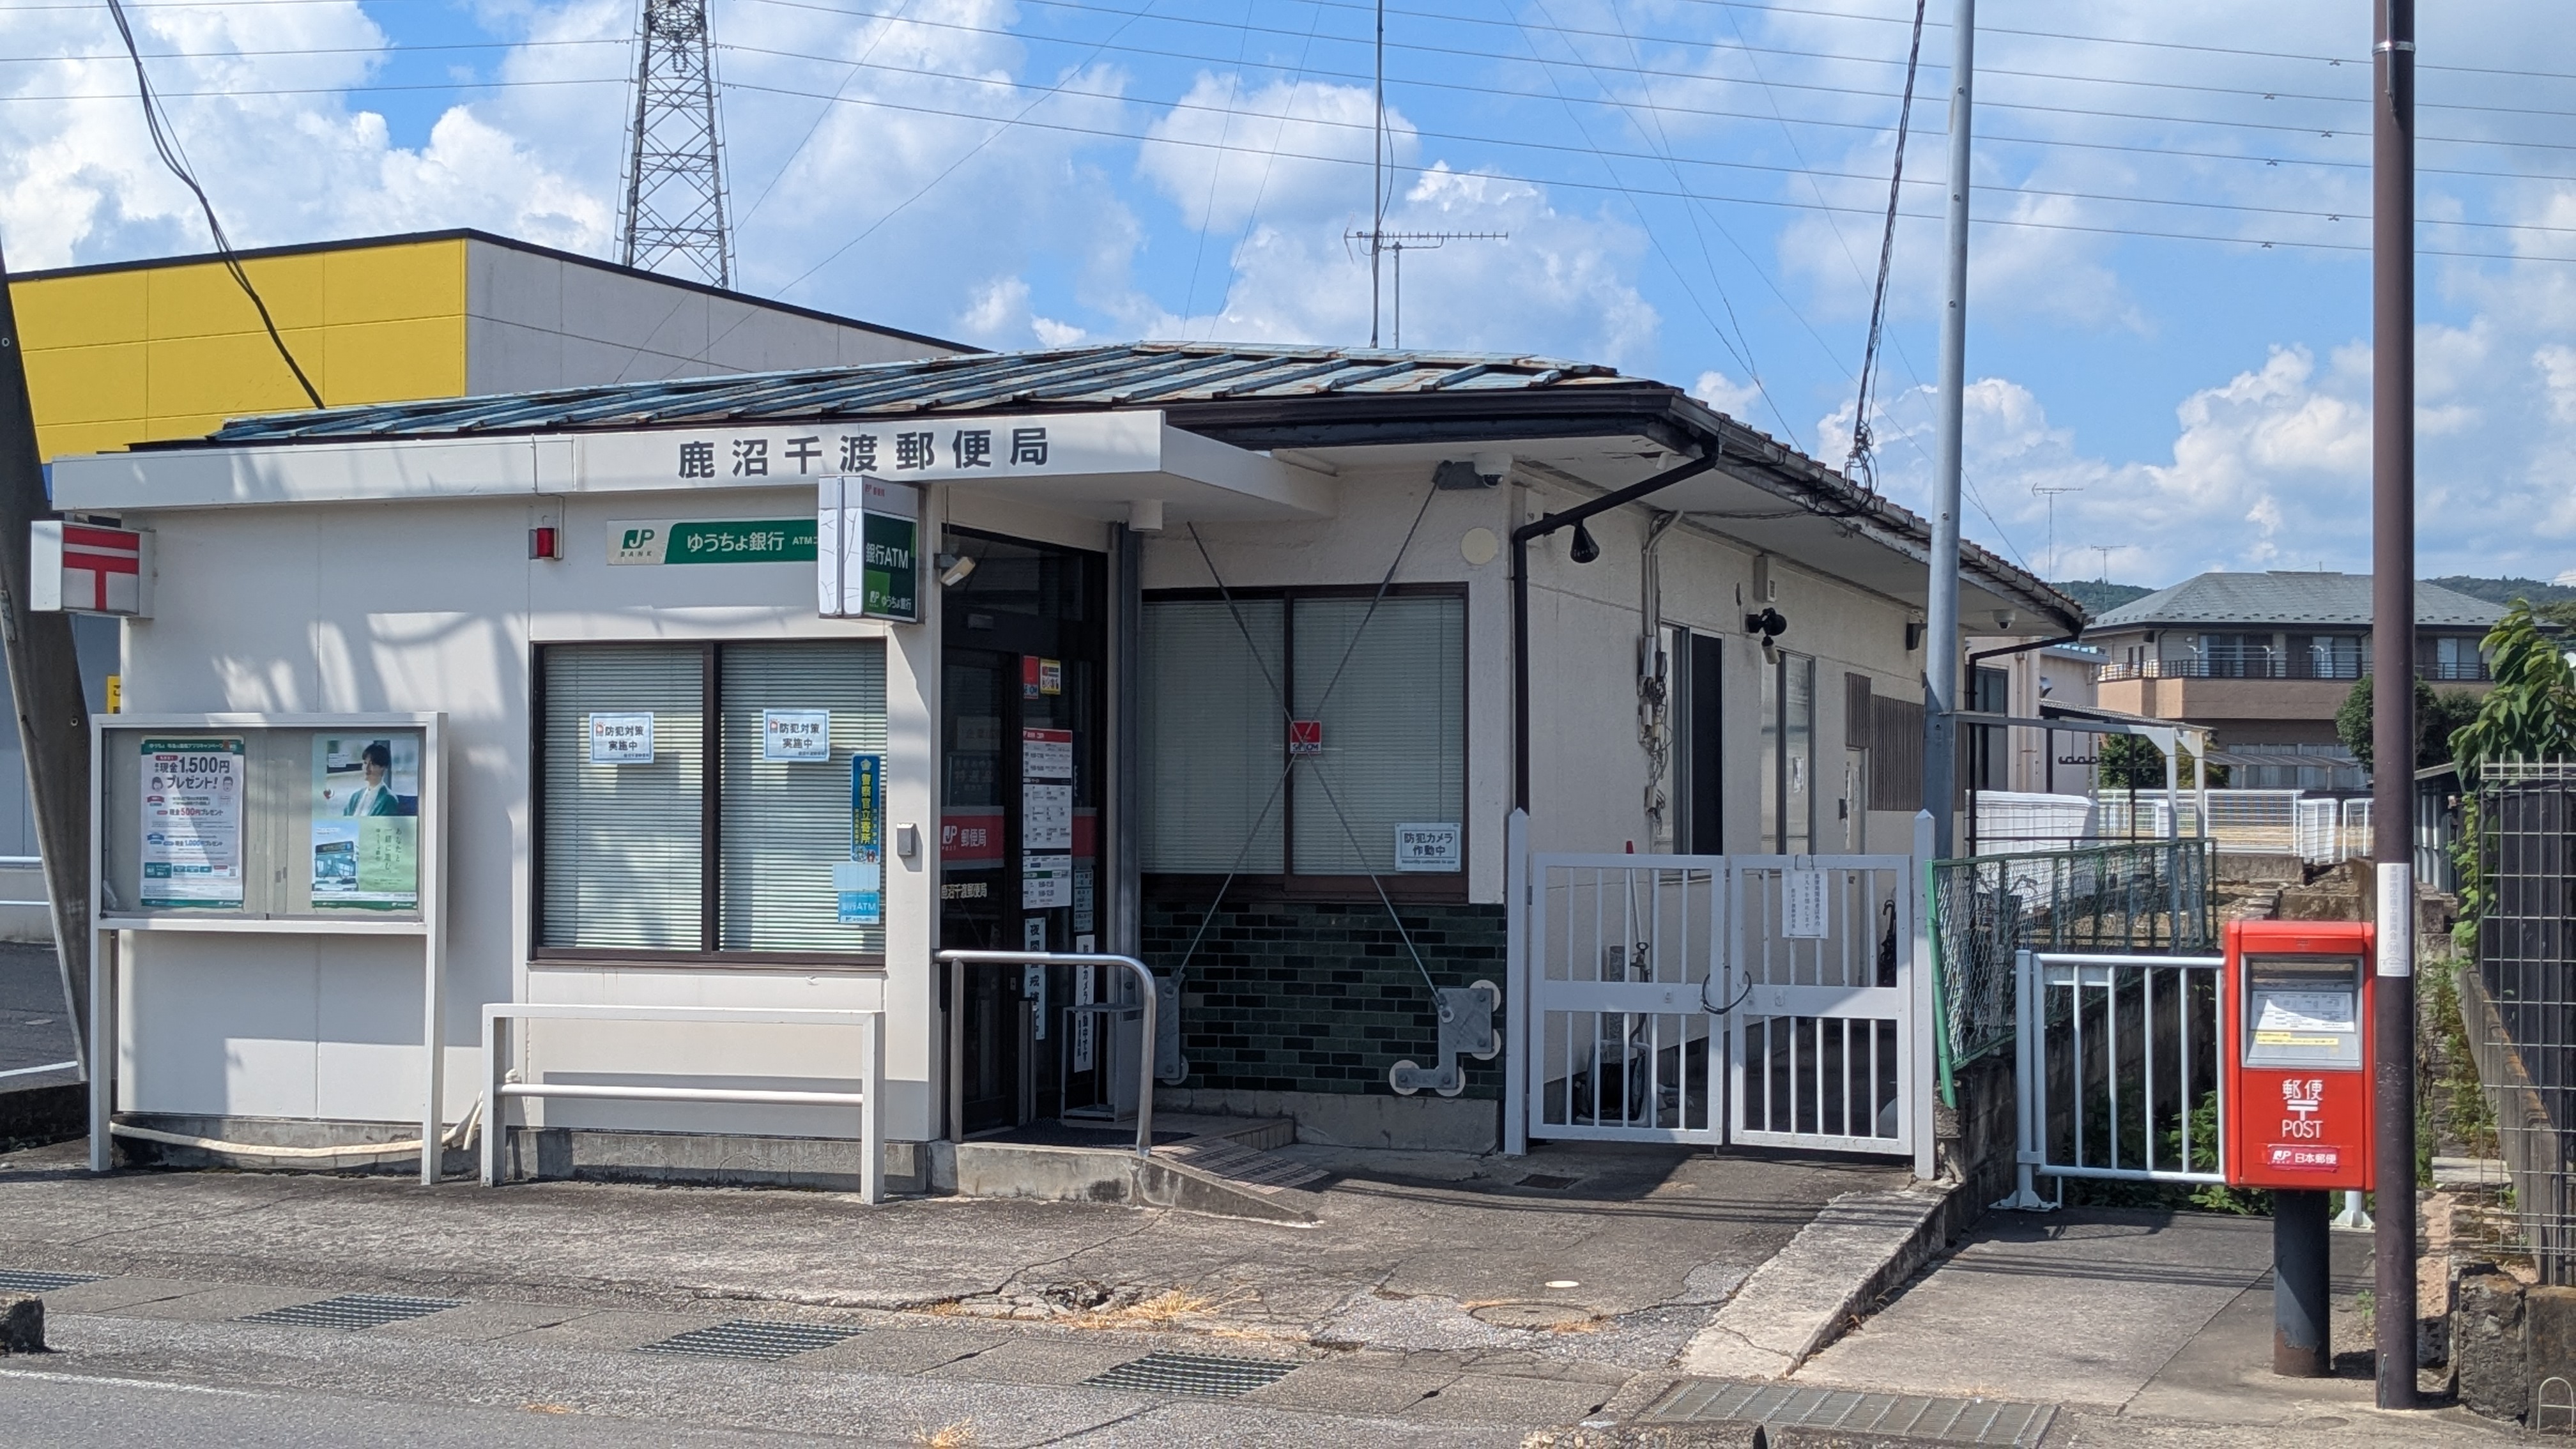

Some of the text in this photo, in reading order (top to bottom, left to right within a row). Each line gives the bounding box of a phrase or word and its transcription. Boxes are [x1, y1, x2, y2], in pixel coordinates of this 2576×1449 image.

[678, 427, 1048, 478] 鹿沼千渡郵便局
[687, 531, 785, 553] ゆうちょ銀行
[866, 542, 908, 569] 銀行ATM
[881, 596, 912, 611] ゆうちょ銀行
[605, 725, 644, 737] 防犯対策
[779, 723, 820, 734] 防犯対策
[608, 740, 638, 751] 実施中
[783, 737, 813, 749] 実施中
[160, 756, 230, 774] 現金1,500円
[861, 772, 871, 845] 警察官立寄所
[960, 828, 986, 847] 郵便局
[1404, 832, 1453, 843] 防犯カメラ
[1413, 845, 1446, 856] 作動中
[2282, 1078, 2323, 1101] 郵便
[2281, 1119, 2324, 1138] POST
[2295, 1153, 2336, 1165] 日本郵便
